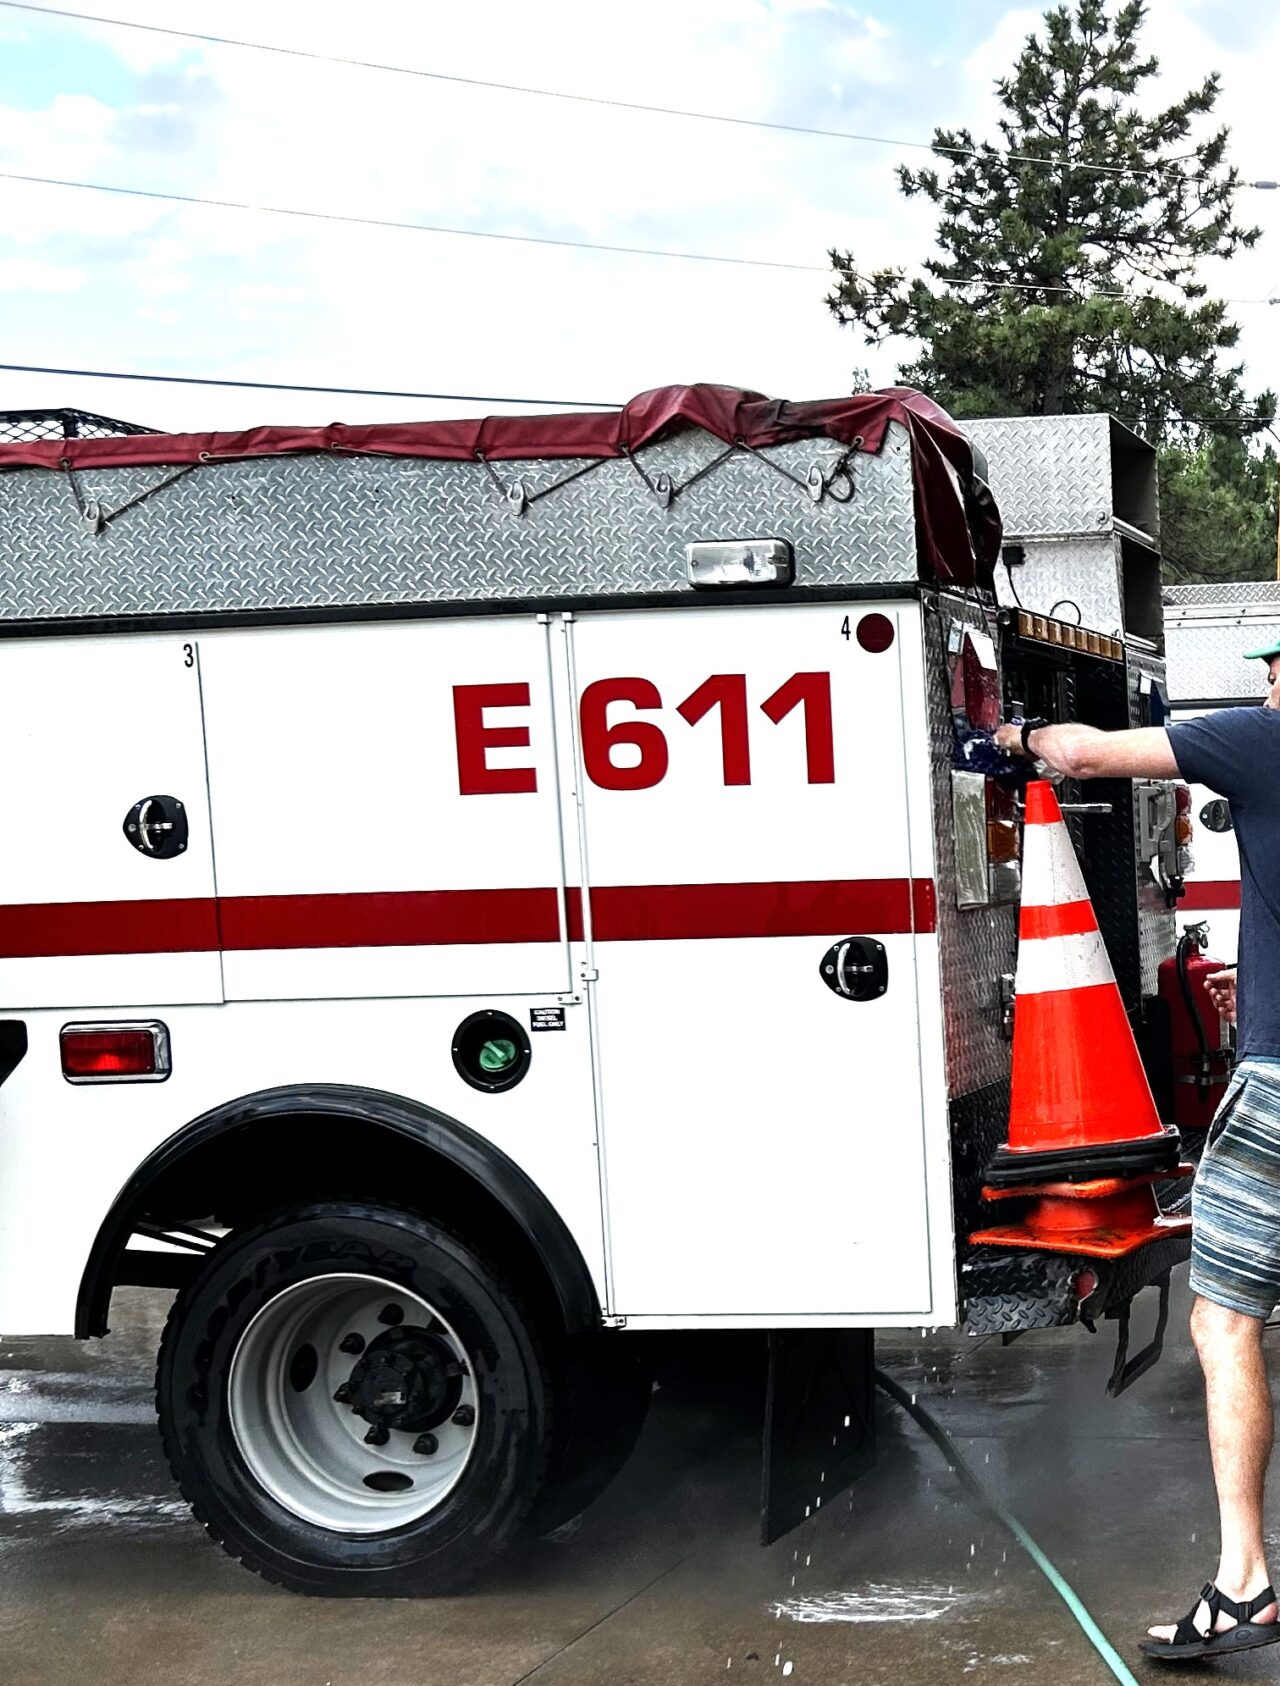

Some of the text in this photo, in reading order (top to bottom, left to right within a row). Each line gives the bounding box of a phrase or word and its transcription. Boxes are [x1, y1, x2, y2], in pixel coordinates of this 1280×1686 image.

[841, 616, 852, 640] 4
[183, 643, 194, 668] 3
[453, 671, 835, 795] E 611
